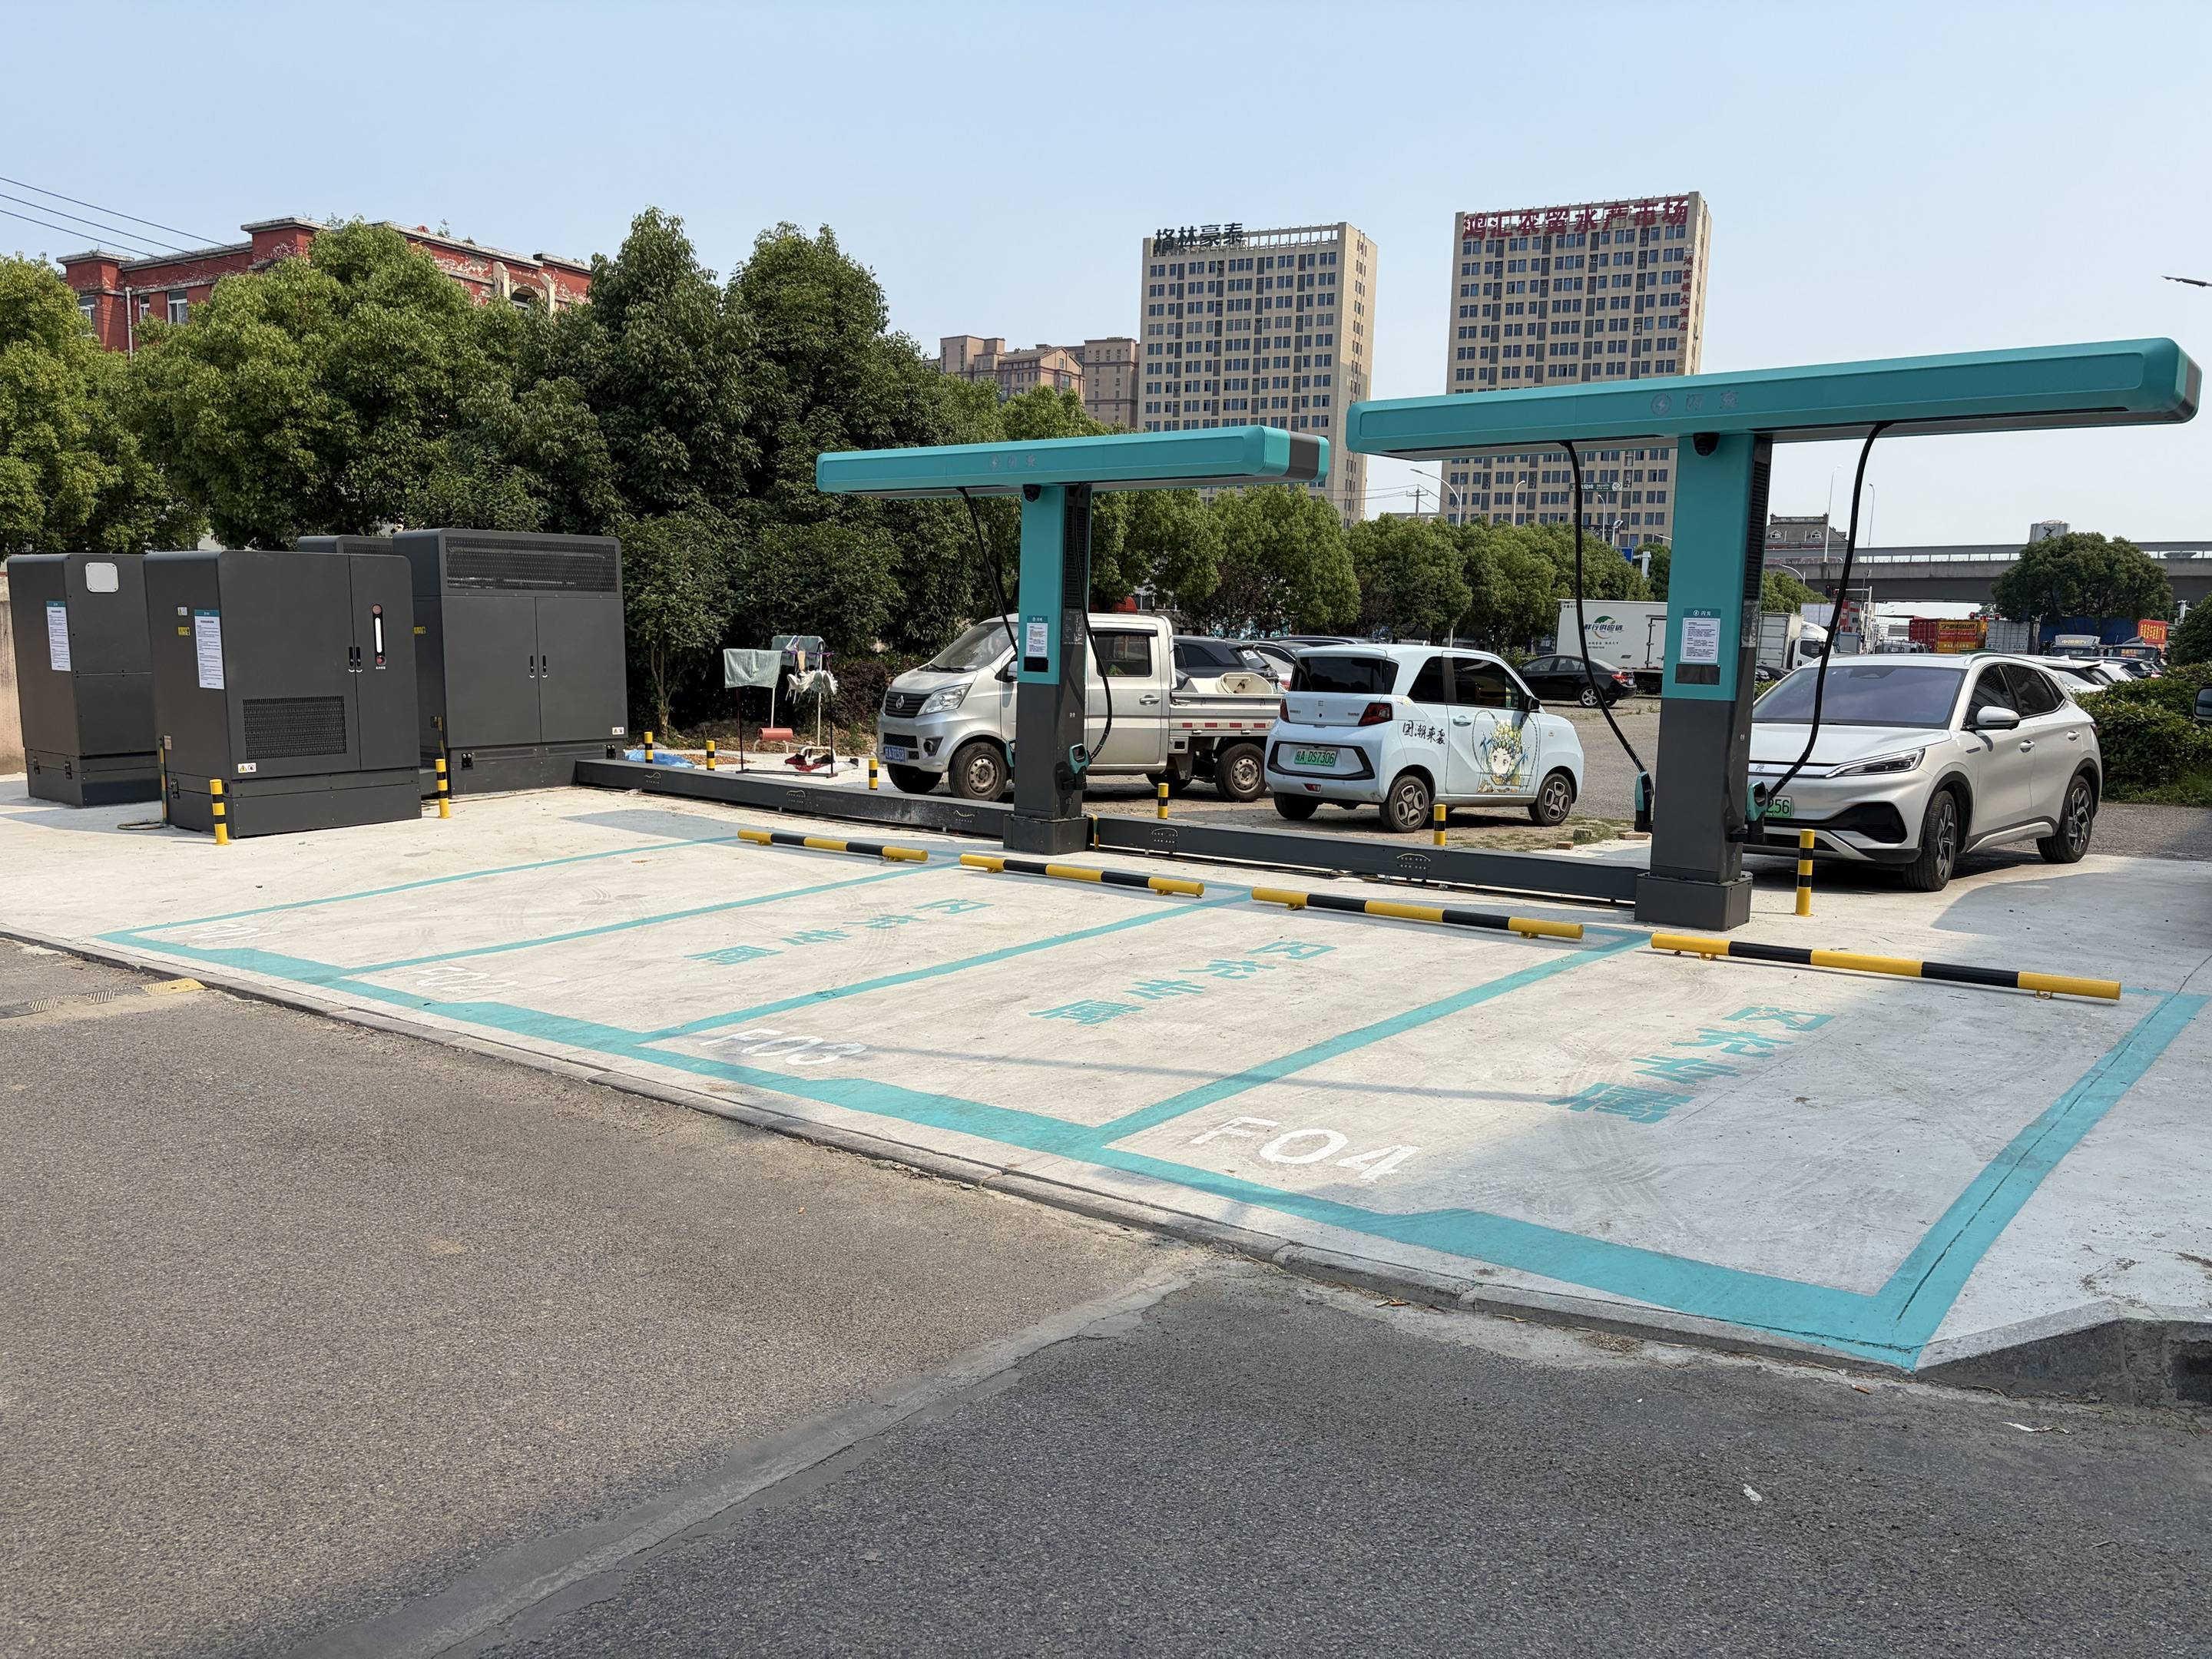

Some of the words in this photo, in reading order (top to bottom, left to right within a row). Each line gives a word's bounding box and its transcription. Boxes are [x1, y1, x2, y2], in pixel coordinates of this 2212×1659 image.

[1154, 223, 1243, 251] 格林豪泰
[1402, 720, 1445, 745] 国潮来袭
[698, 1028, 867, 1066] F03
[1190, 1116, 1426, 1184] F04
